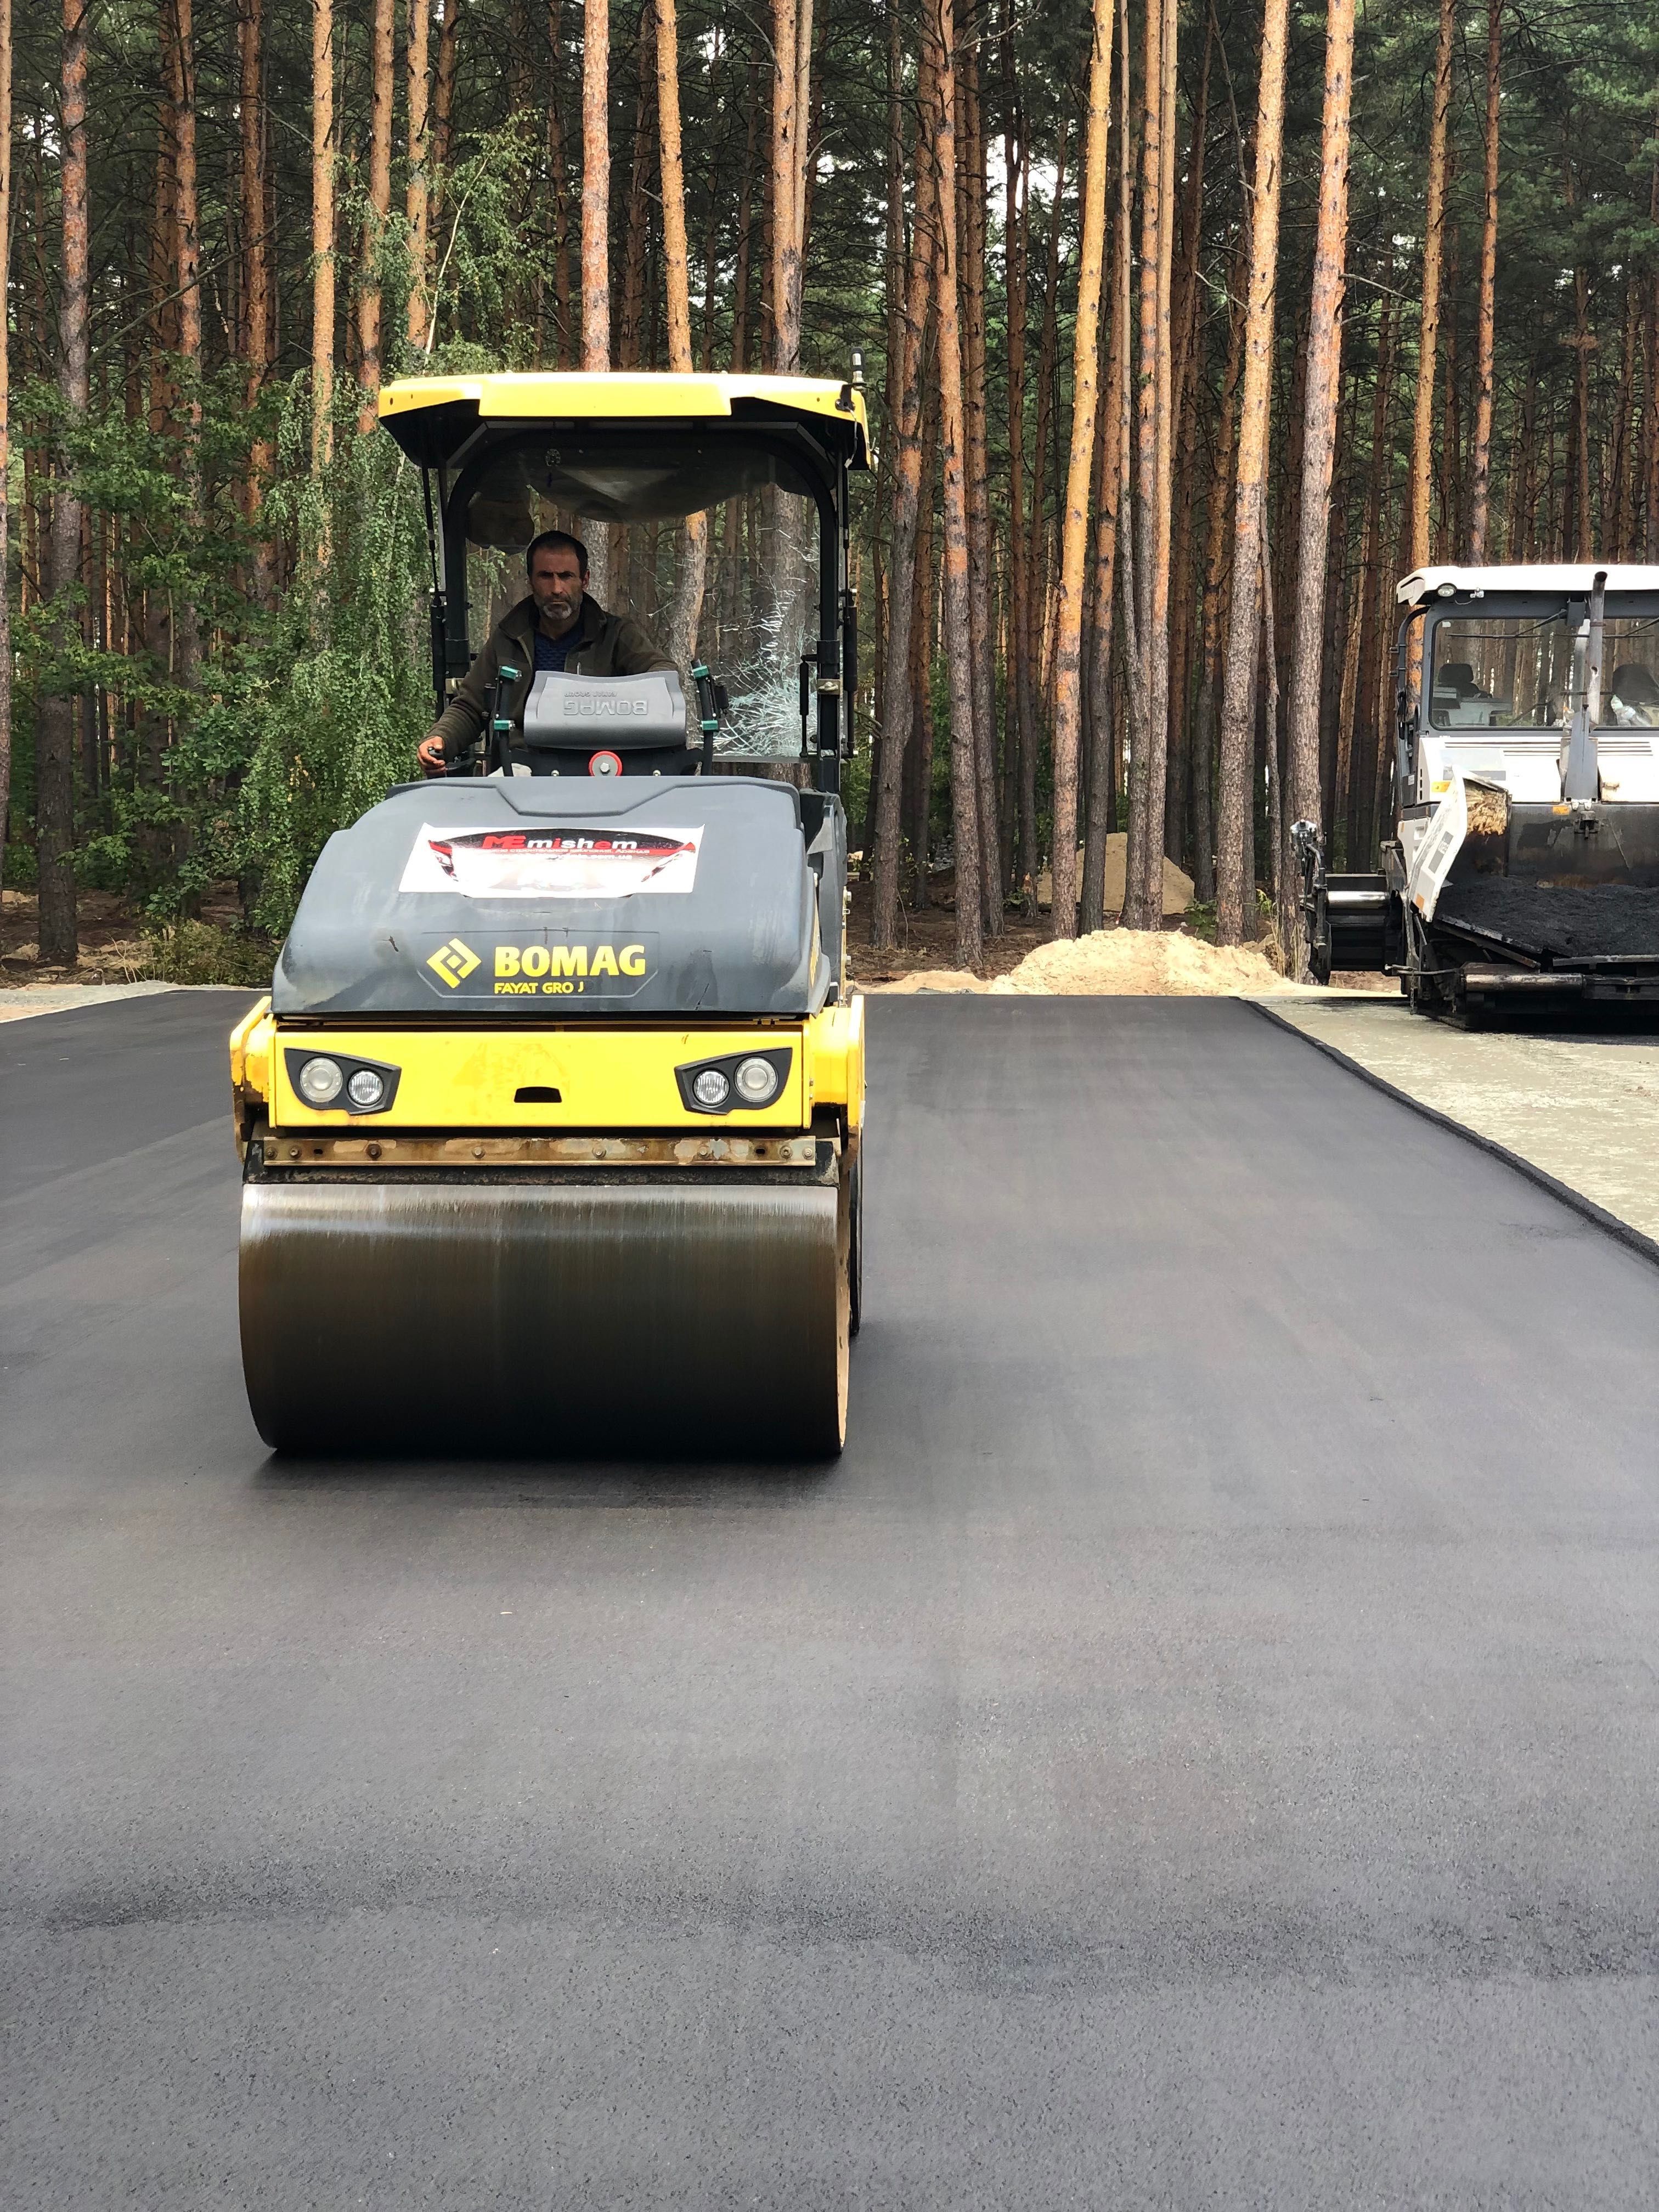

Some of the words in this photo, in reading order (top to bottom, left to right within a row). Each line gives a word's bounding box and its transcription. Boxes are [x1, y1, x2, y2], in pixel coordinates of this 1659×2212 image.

[563, 699, 648, 715] BOMAG
[527, 838, 638, 849] mishem
[495, 945, 646, 977] BOMAG
[494, 981, 538, 994] FAYAT
